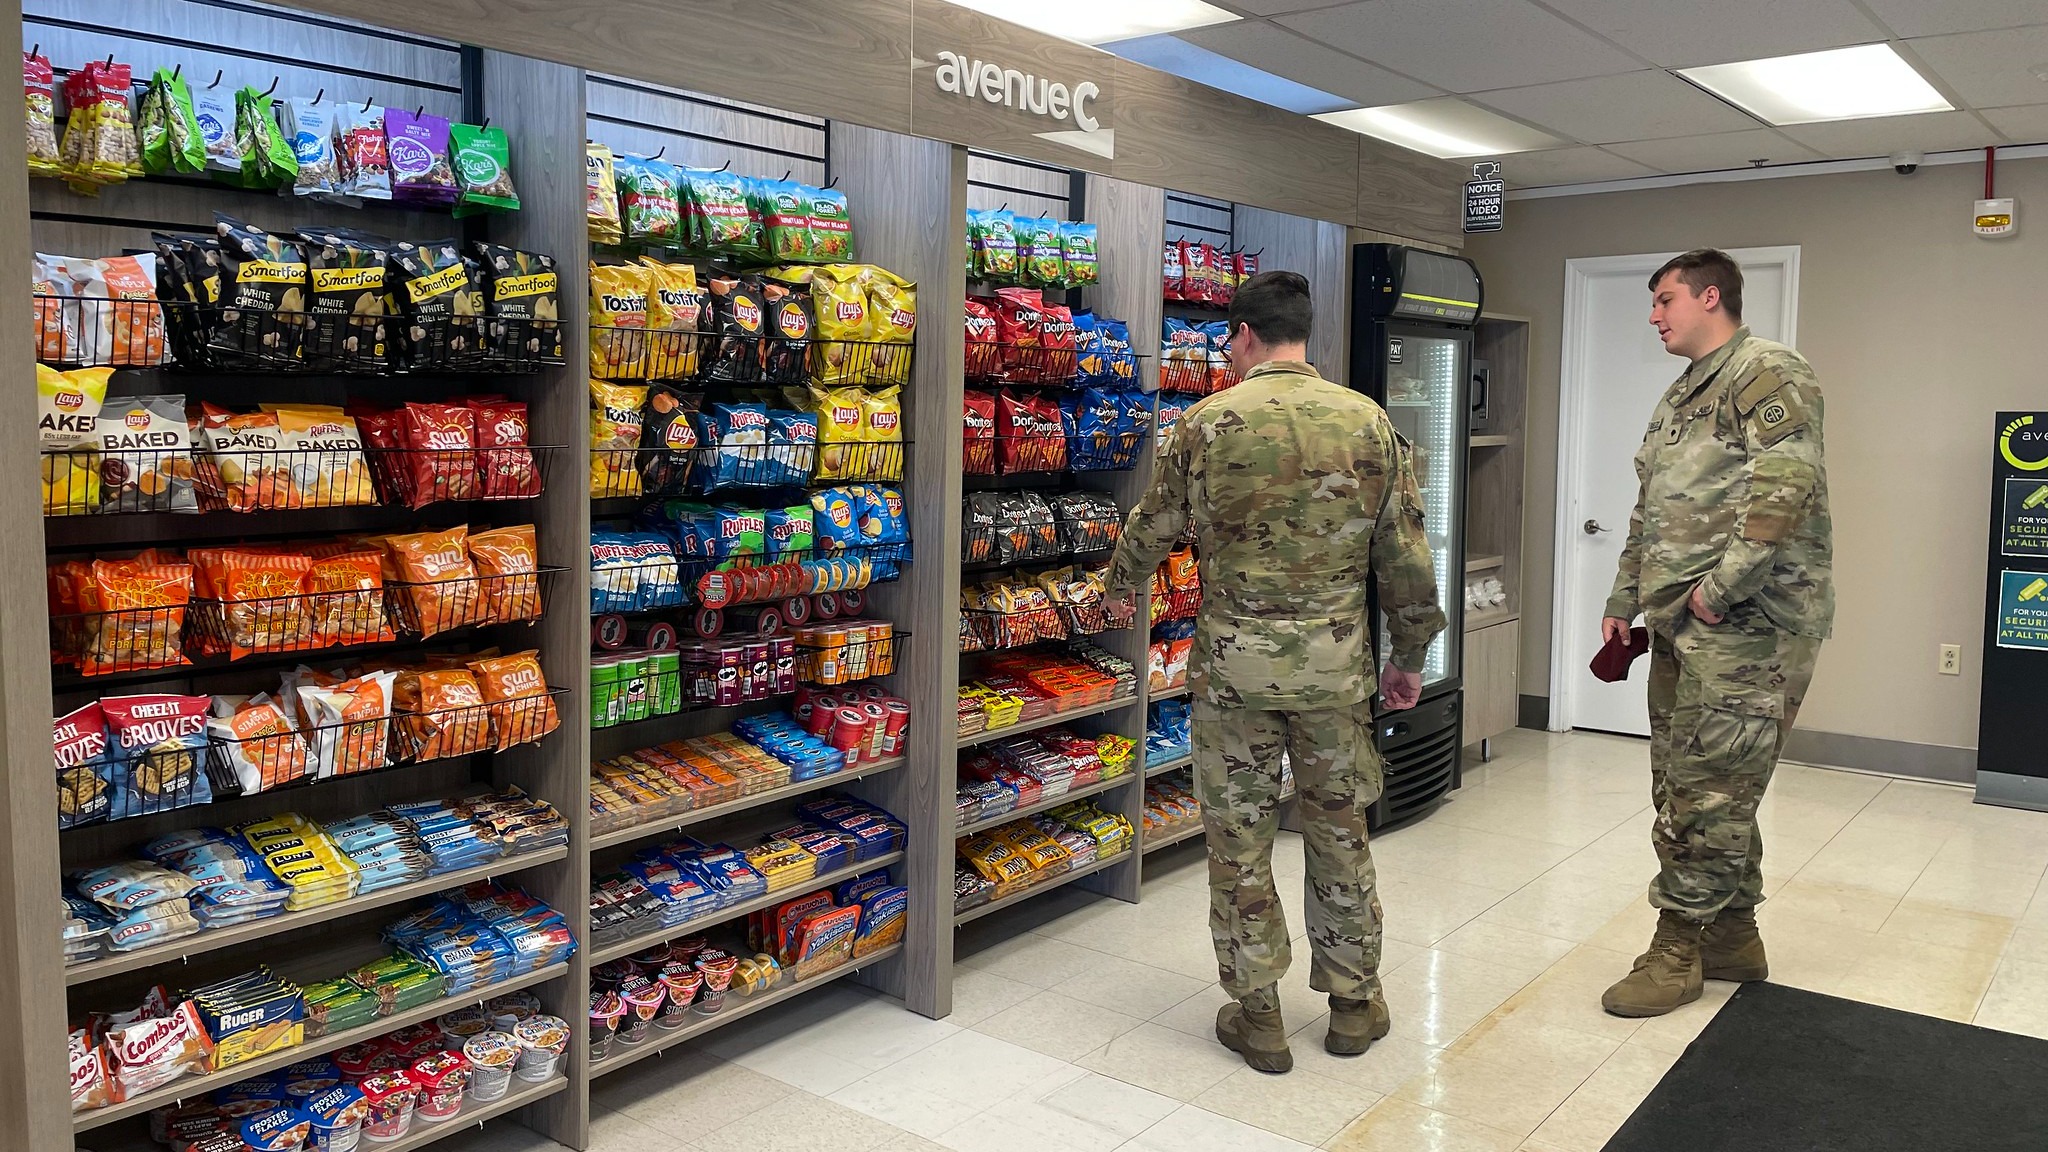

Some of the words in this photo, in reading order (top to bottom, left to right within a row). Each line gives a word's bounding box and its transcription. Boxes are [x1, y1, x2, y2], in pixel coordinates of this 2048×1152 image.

[1468, 183, 1502, 194] NOTICE
[1468, 199, 1478, 207] 24
[1478, 197, 1501, 206] HOUR
[1469, 205, 1499, 216] VIDEO
[242, 263, 307, 280] Smartfoo
[243, 287, 271, 301] WHITE
[498, 277, 556, 295] Smartfood
[235, 296, 275, 311] CHEDDAR
[318, 297, 345, 308] WHITE
[419, 303, 446, 314] WHITE
[502, 304, 526, 313] WHITE
[838, 300, 863, 320] Lay's
[737, 304, 759, 323] Lay's
[782, 311, 806, 330] Lay's
[891, 309, 915, 329] Lay's
[1044, 322, 1076, 333] Doritos
[1102, 337, 1129, 348] Doritos
[1390, 343, 1402, 355] PAY
[835, 406, 860, 424] Lay's
[872, 411, 898, 429] Lay's
[310, 422, 345, 438] RUFFLES
[668, 423, 696, 444] Lay's
[786, 422, 818, 441] RUFFLES
[103, 431, 179, 450] BAKED
[215, 432, 277, 450] BAKED
[297, 439, 362, 450] BAKED
[831, 506, 850, 522] Lay's
[722, 517, 764, 538] RUFFLES
[773, 519, 812, 540] RUFFLES
[2020, 539, 2038, 547] ALL
[423, 549, 464, 576] Sun
[2013, 608, 2029, 616] FOR
[2016, 631, 2034, 639] ALL
[501, 669, 536, 697] Sun
[514, 680, 541, 693] CHIPS
[348, 705, 381, 720] SIMPLY
[237, 710, 272, 733] SIMPLY
[120, 714, 203, 749] GROOVES
[841, 814, 871, 828] CRUNCH
[341, 827, 371, 838] QUEST
[858, 824, 887, 837] CRUNCH
[265, 839, 300, 852] LUNA
[347, 847, 378, 859] QUEST
[807, 837, 841, 854] CRUNCH
[276, 851, 311, 864] LUNA
[855, 876, 887, 892] Maruchan
[796, 897, 828, 911] Maruchan
[822, 912, 856, 926] Maruchan
[870, 900, 907, 927] Yakisoba
[810, 922, 852, 951] Yakisoba
[698, 952, 713, 962] STIR
[713, 950, 727, 959] FRY
[662, 965, 677, 976] STIR
[676, 964, 692, 975] FRY
[622, 980, 636, 992] STIR
[635, 976, 651, 989] FRY
[220, 1008, 265, 1032] RUGER
[128, 1009, 185, 1059] Combos
[524, 1023, 554, 1036] Crunch
[473, 1041, 506, 1054] Crunch
[308, 1087, 343, 1113] FROSTED
[317, 1093, 346, 1115] FLAKES
[249, 1109, 288, 1132] FROSTED
[256, 1115, 290, 1135] FLAKES
